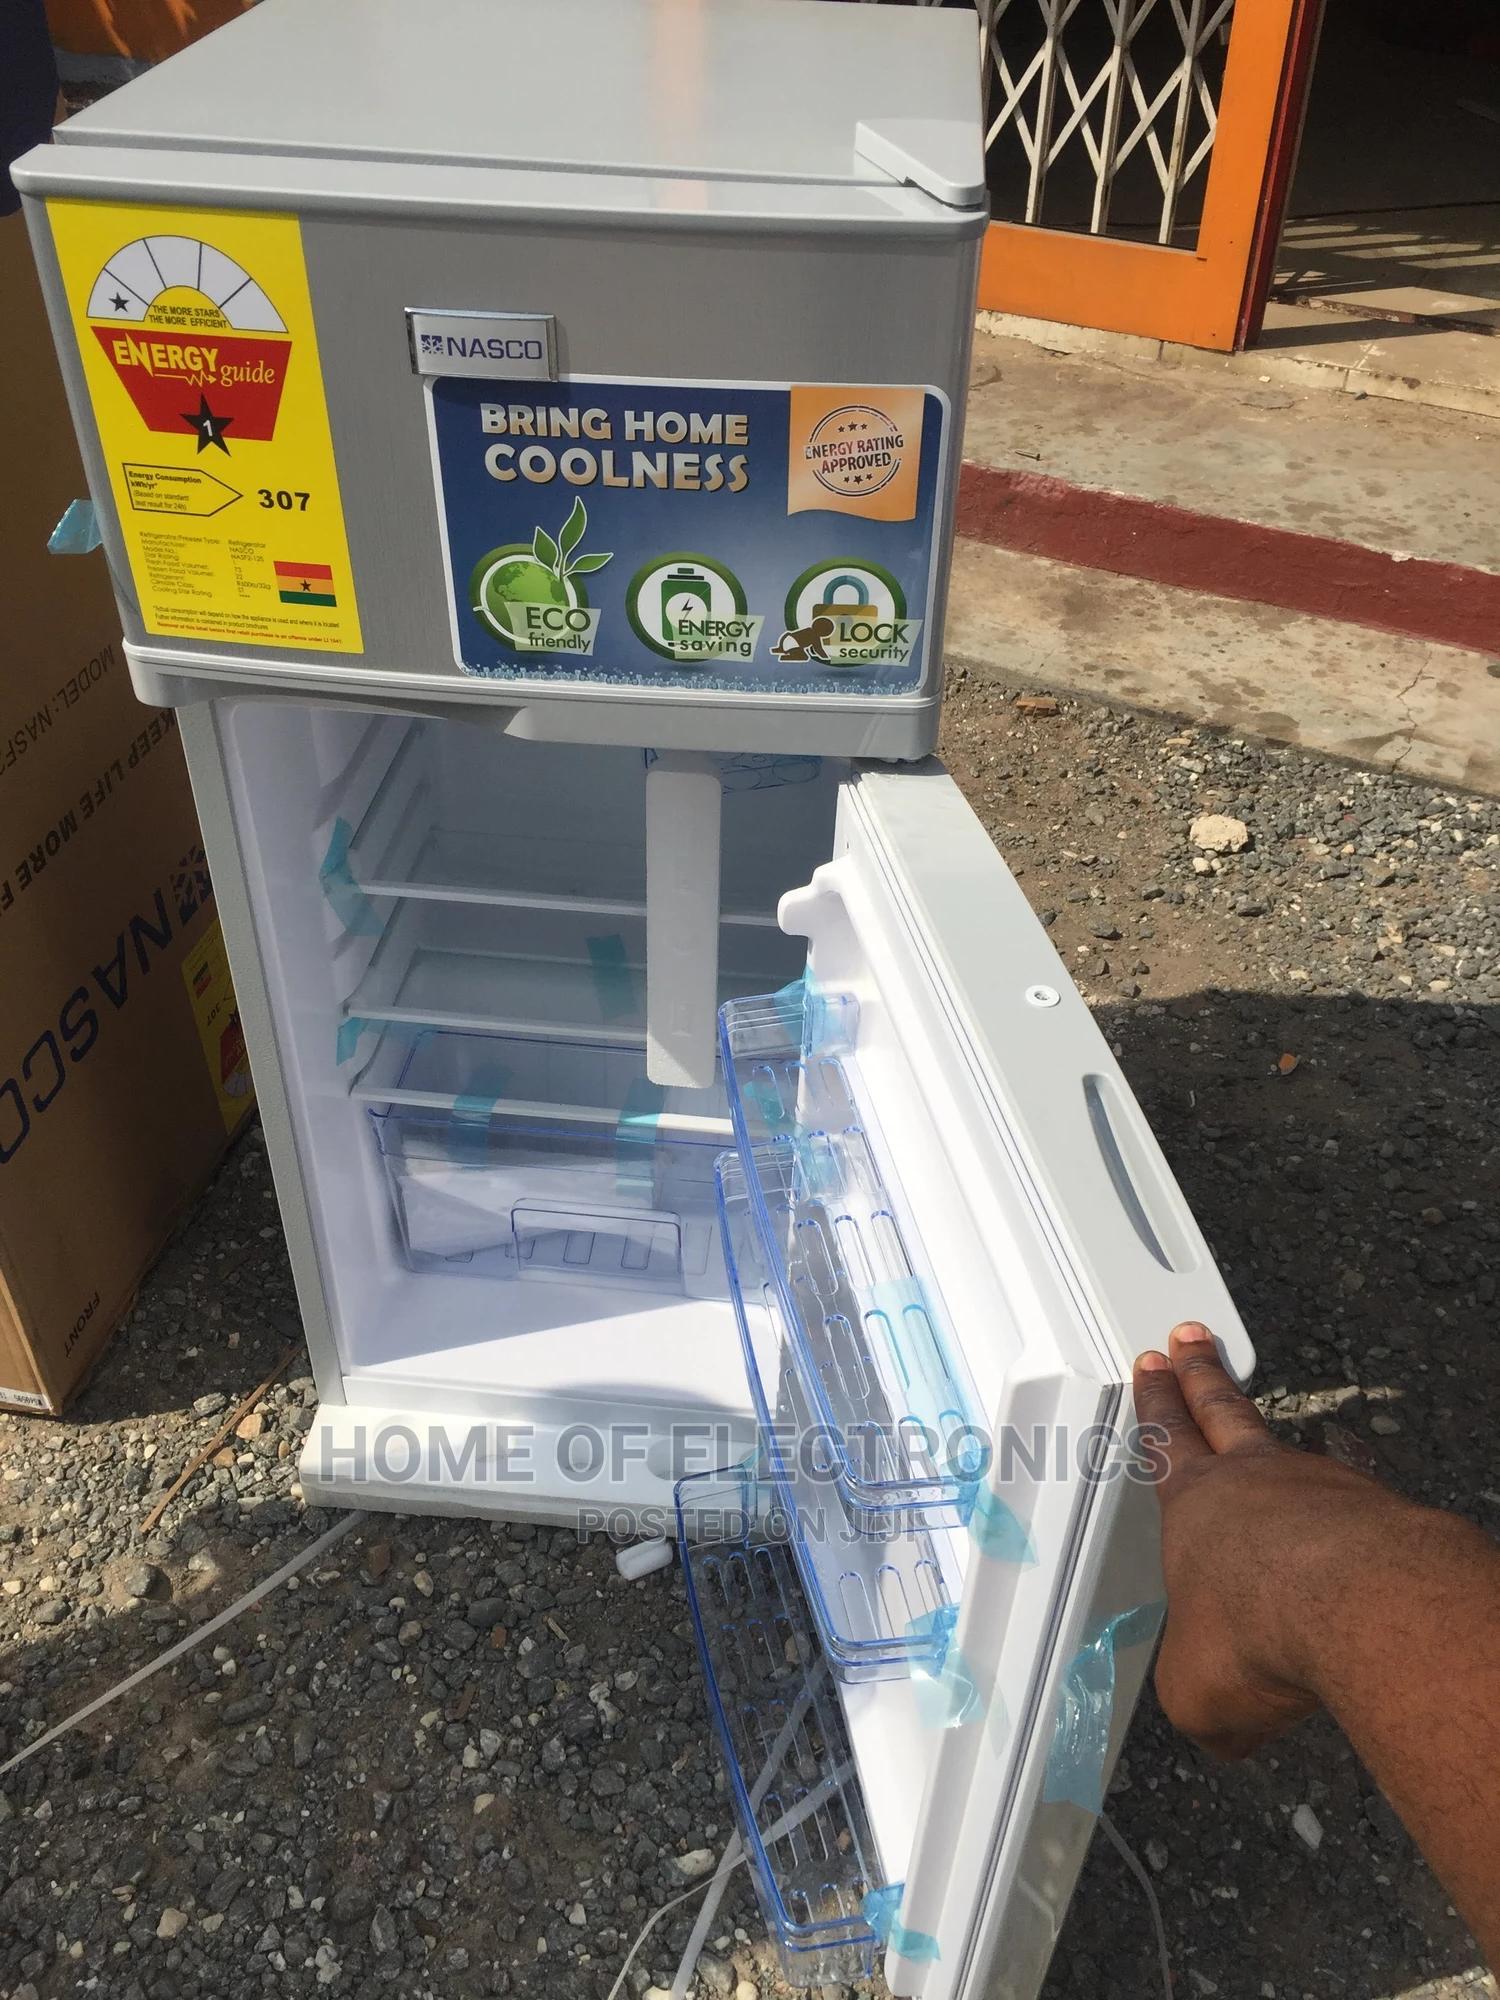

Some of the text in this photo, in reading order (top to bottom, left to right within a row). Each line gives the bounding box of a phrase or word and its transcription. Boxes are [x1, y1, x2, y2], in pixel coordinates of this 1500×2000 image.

[148, 314, 228, 329] THE MORE EFFICIENT
[152, 304, 220, 318] THE MORE STARS
[112, 332, 275, 387] ENERGY guide
[447, 336, 543, 361] NASCO
[203, 419, 213, 437] 1
[480, 402, 749, 446] BRING HOME
[805, 433, 904, 460] ENERGY RATING
[484, 443, 750, 493] COOLNESS
[821, 451, 892, 475] APPROVED
[155, 473, 202, 484] Consumption
[257, 488, 311, 511] 307
[526, 607, 591, 632] ECO
[678, 619, 755, 638] ENERGY
[528, 632, 591, 653] friendly
[840, 622, 909, 644] LOCK
[680, 636, 752, 657] saving
[840, 645, 909, 662] security
[79, 759, 126, 821] LIFE
[15, 809, 79, 891] MORE
[64, 1291, 100, 1359] FRONT
